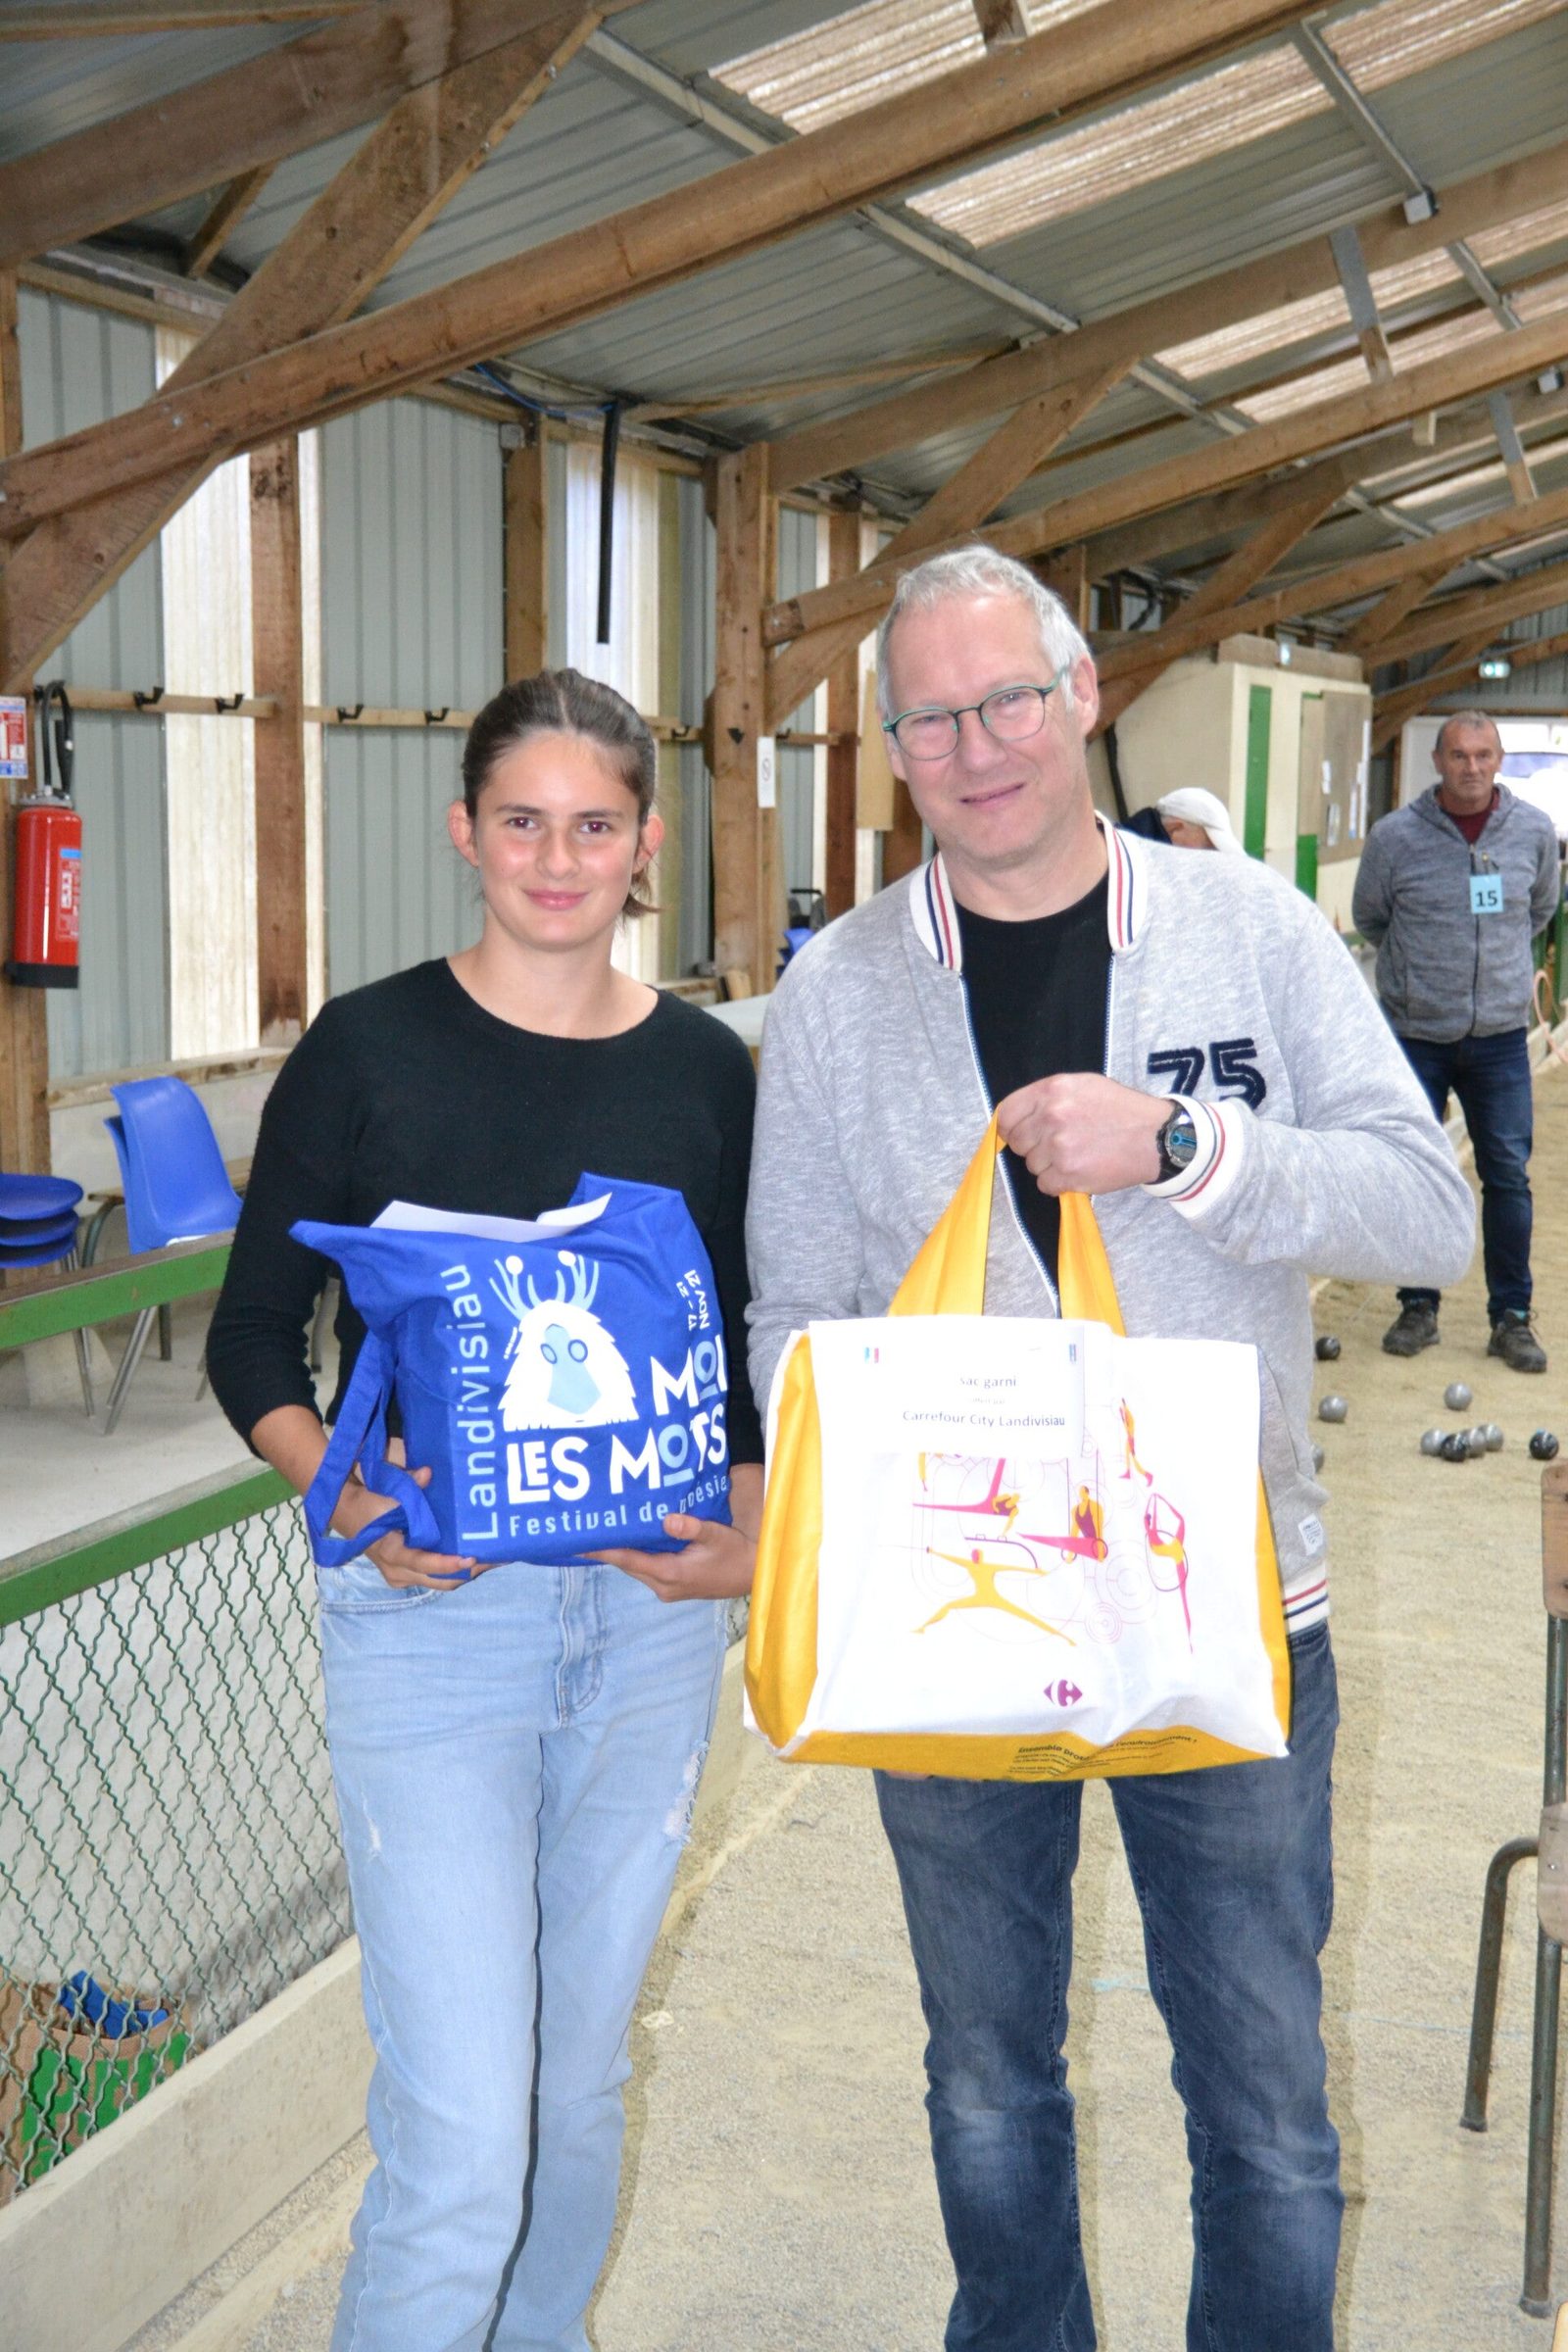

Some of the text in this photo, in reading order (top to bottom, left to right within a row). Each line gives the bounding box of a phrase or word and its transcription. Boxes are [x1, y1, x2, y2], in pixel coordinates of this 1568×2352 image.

[1475, 890, 1498, 907] 15
[1147, 1038, 1266, 1110] 75
[683, 1269, 710, 1330] NOV 21
[440, 1264, 500, 1541] Landivisiau
[650, 1334, 728, 1417] MOI
[983, 1375, 1017, 1390] garni
[903, 1410, 1065, 1428] Carrefour City Landivisiau
[507, 1402, 727, 1505] LES MOTS
[510, 1504, 627, 1538] Festival
[639, 1500, 668, 1523] de
